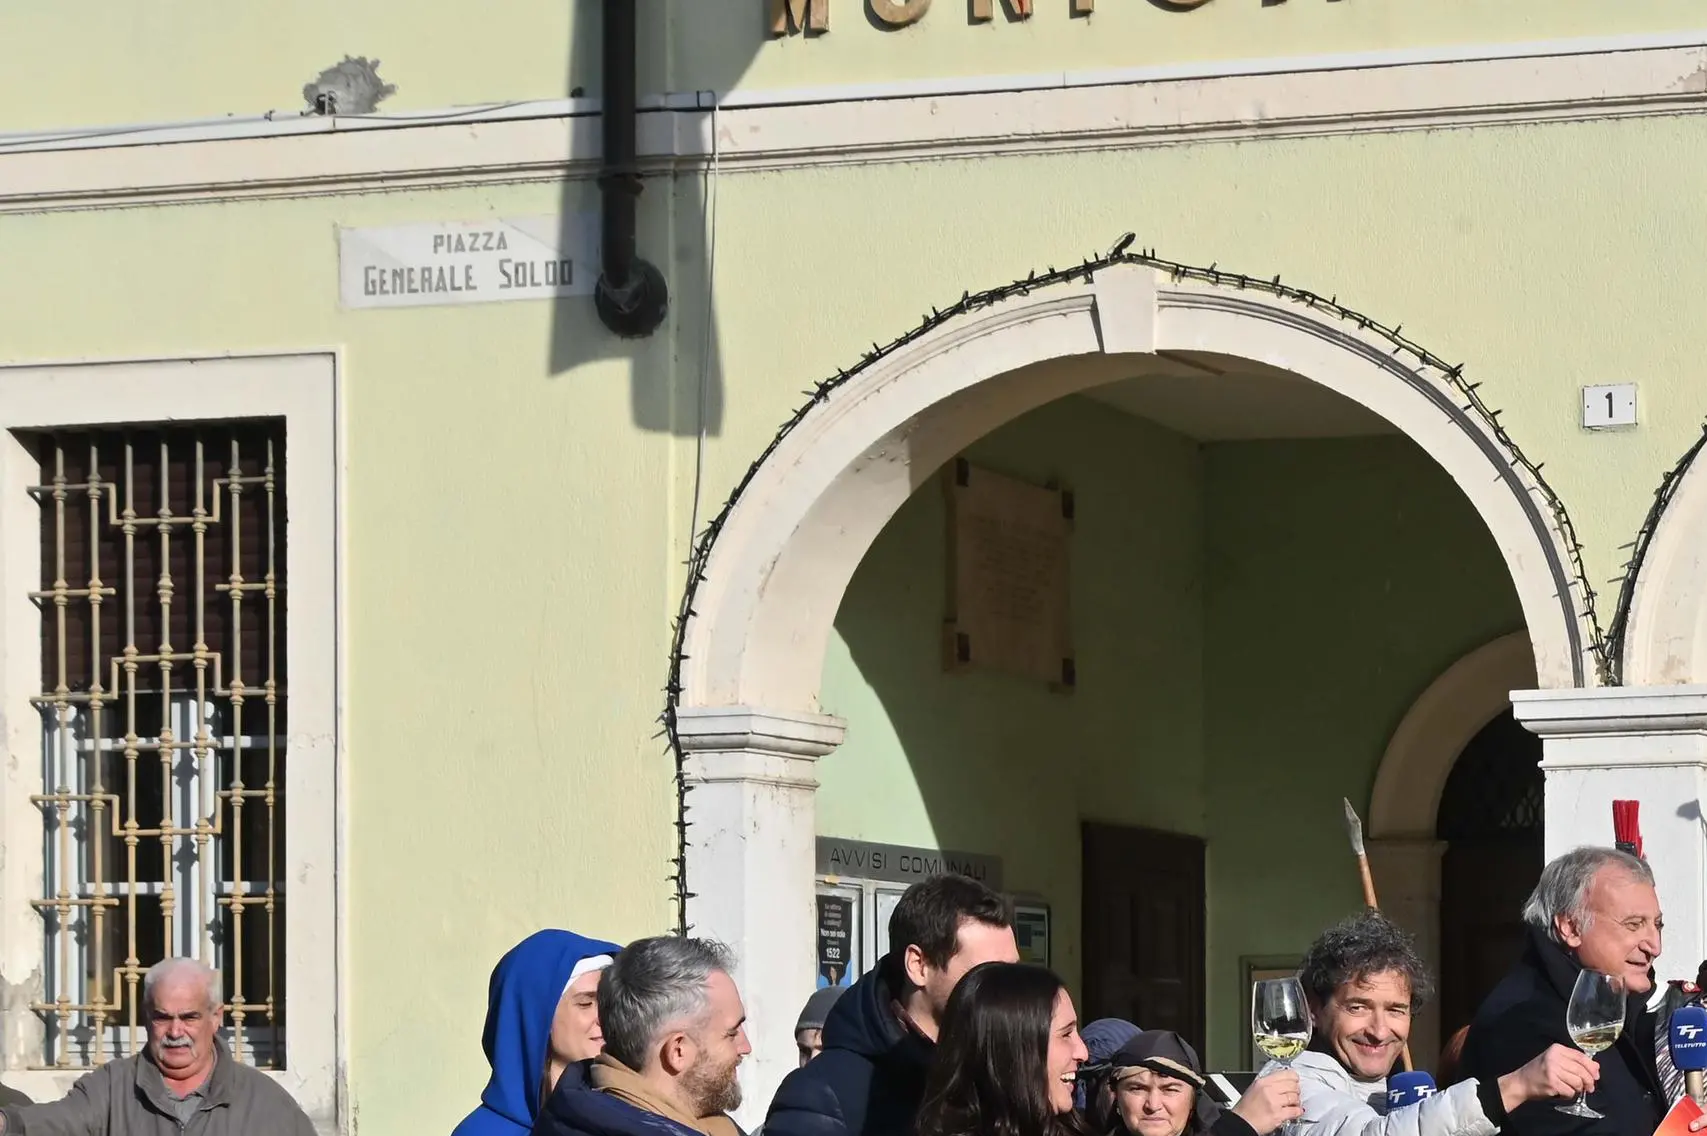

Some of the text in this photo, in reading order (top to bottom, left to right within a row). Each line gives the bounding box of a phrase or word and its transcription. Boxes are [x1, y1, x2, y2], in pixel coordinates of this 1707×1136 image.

[433, 231, 508, 254] PIAZZA
[363, 257, 574, 296] GENERALE SOLDO
[1604, 391, 1614, 419] 1
[830, 847, 987, 881] AVVISI COMUNALI
